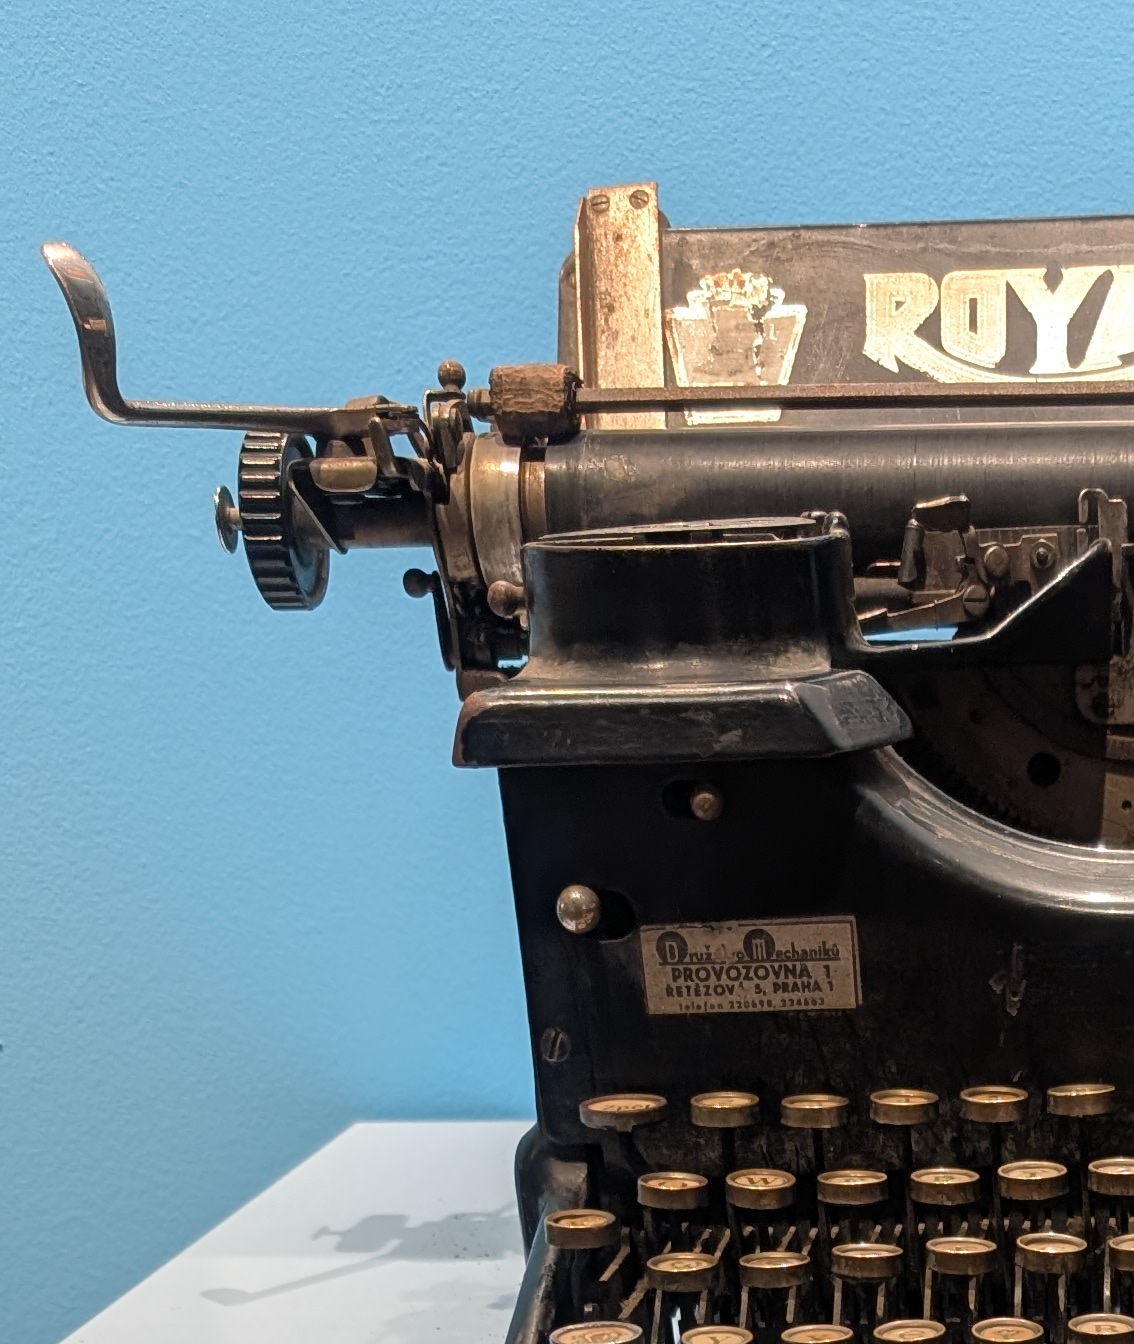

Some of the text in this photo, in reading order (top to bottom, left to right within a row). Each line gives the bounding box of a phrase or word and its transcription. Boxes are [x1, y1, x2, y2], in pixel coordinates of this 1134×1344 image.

[671, 963, 831, 983] PROVOZOVNA 1
[773, 980, 822, 994] PRAHA
[827, 981, 834, 992] 1
[746, 1177, 777, 1185] W
[708, 1336, 731, 1344] Y
